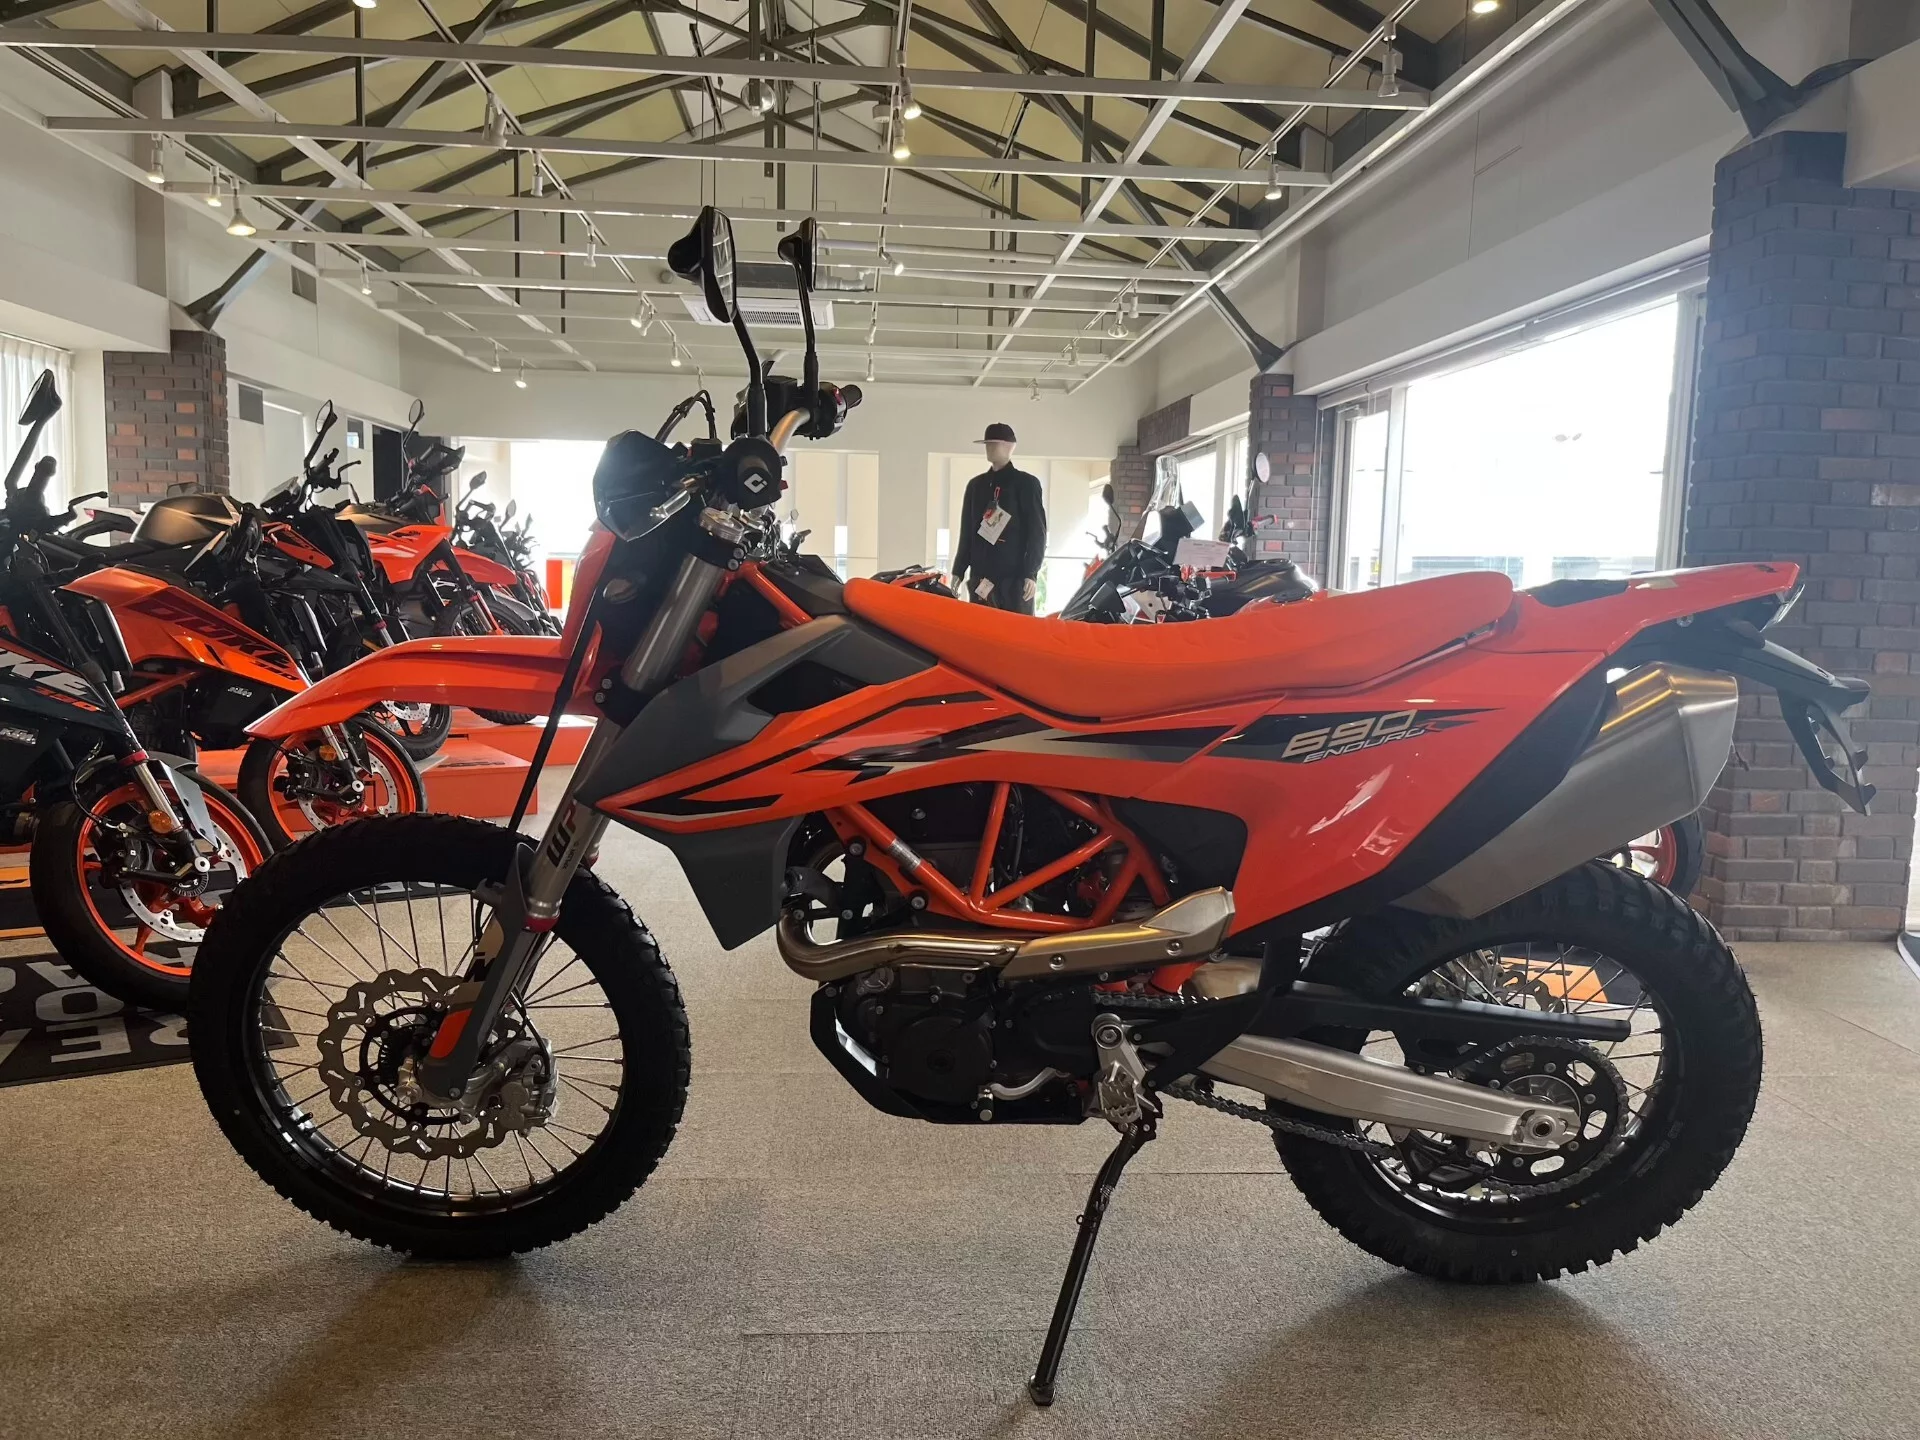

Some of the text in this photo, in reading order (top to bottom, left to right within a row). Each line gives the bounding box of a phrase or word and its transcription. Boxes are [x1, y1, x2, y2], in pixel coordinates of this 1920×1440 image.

[126, 586, 292, 669] DUKE
[0, 648, 92, 696] KE
[1281, 709, 1418, 758] 690
[1303, 728, 1426, 763] ENDURO
[545, 801, 577, 868] WP
